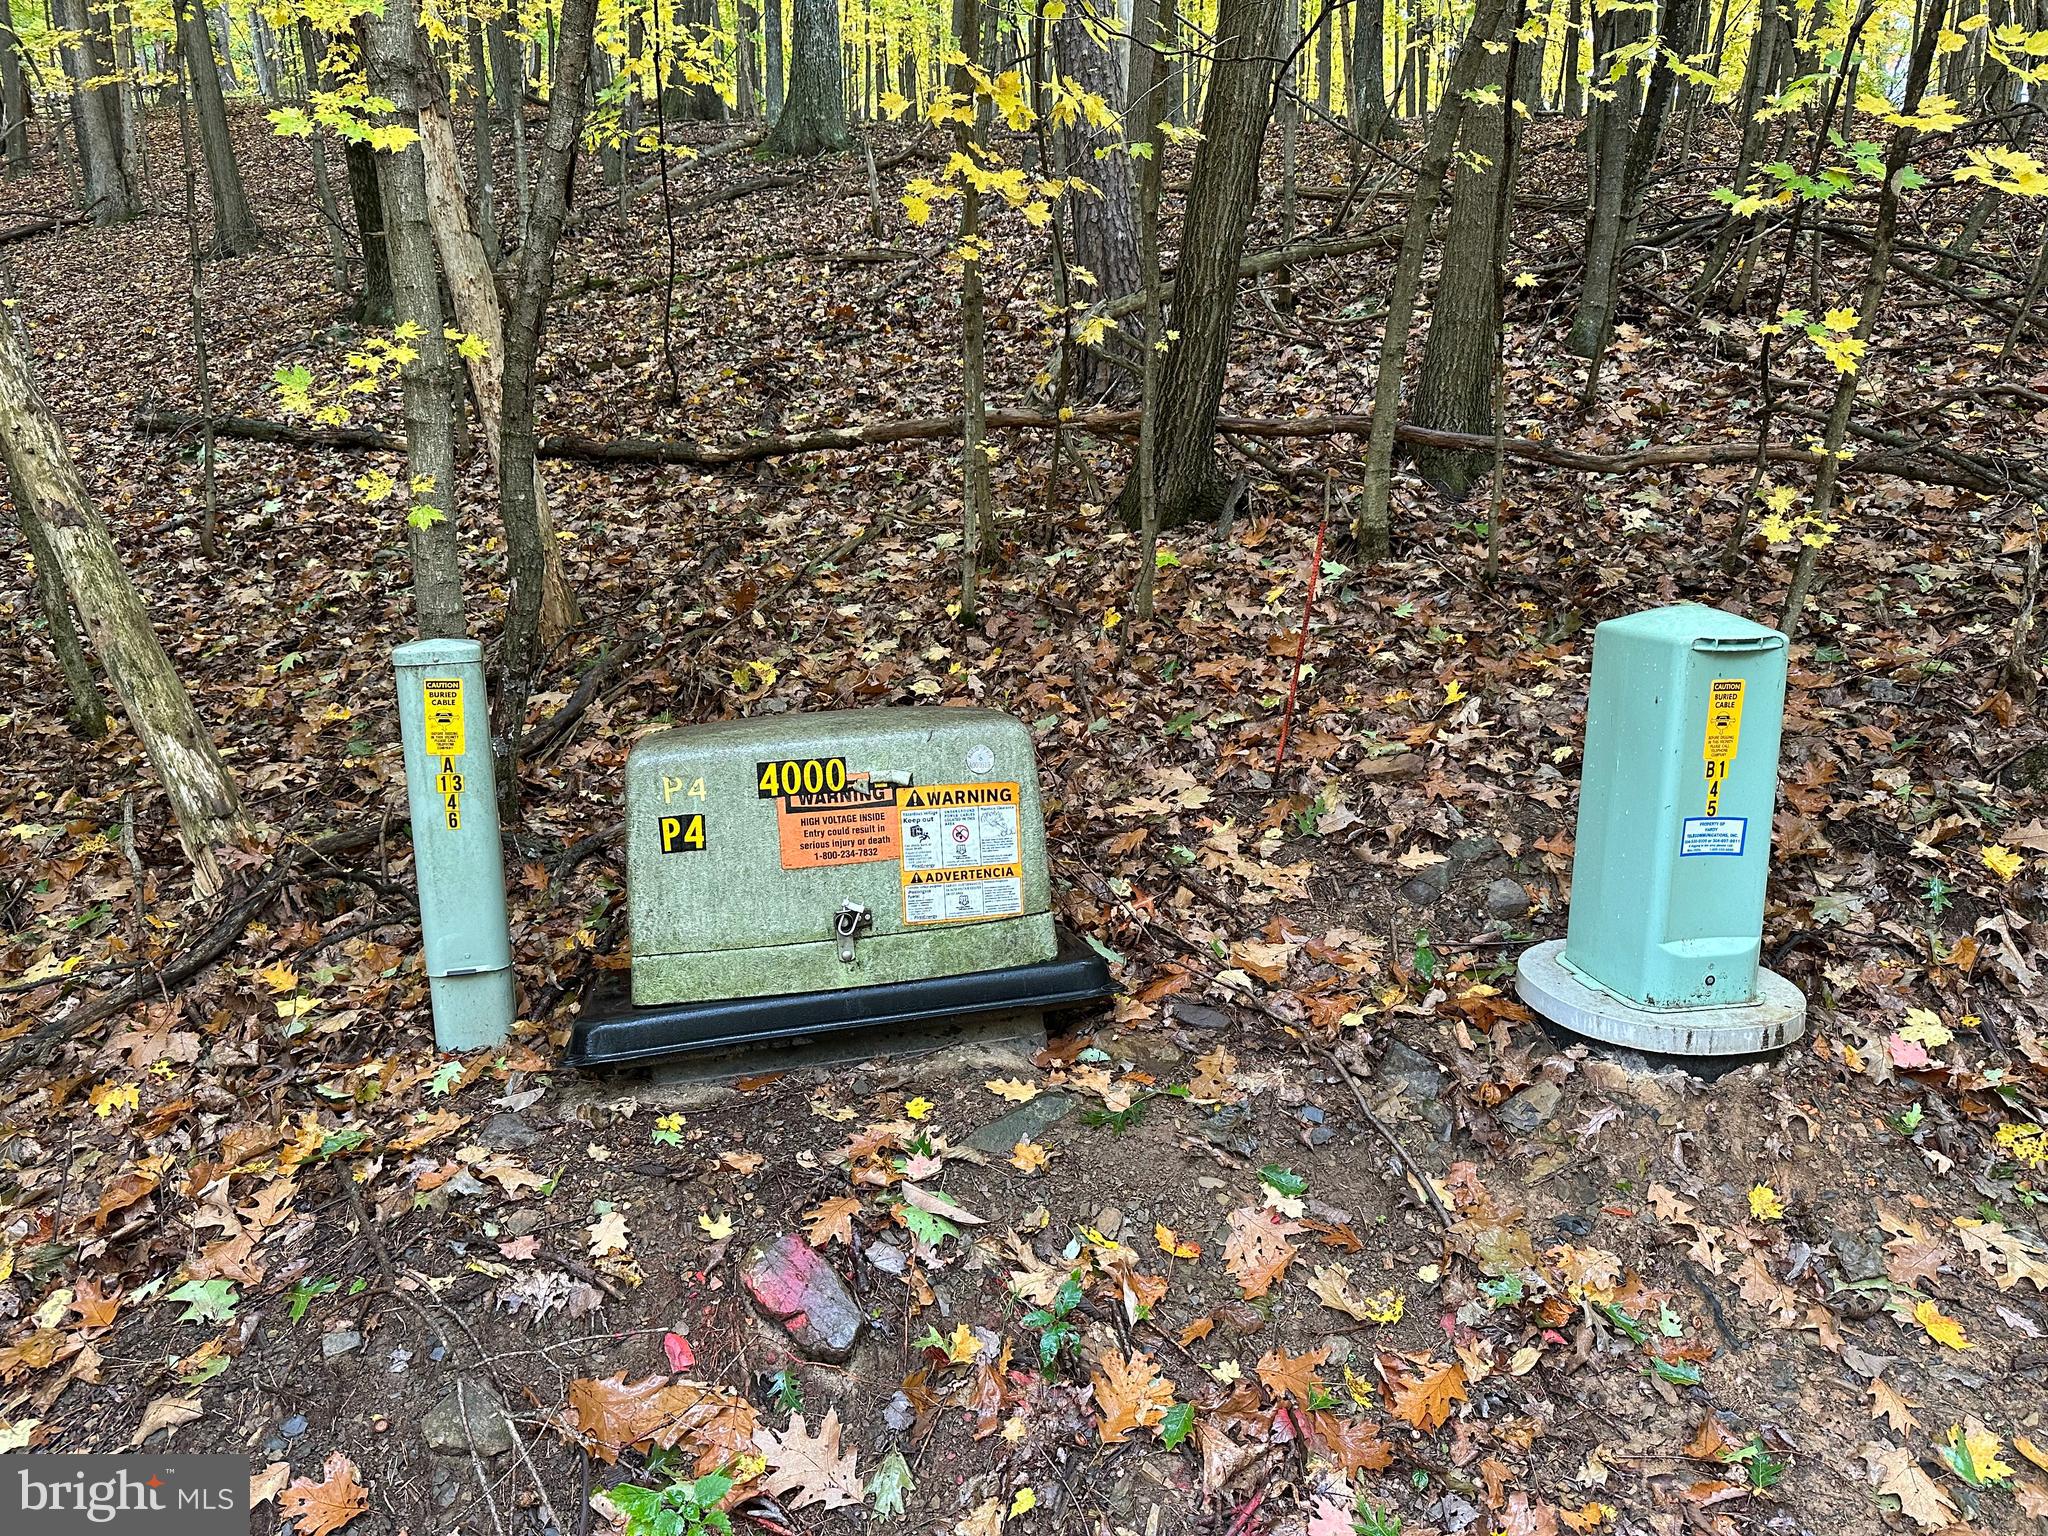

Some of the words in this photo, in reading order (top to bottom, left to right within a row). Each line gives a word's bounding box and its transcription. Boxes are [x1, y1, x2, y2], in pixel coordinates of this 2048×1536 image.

[1714, 693, 1738, 701] BURIED
[443, 757, 454, 773] A
[1706, 760, 1725, 778] B1
[440, 775, 463, 791] 13
[759, 758, 846, 797] 4000
[799, 786, 885, 806] WARNING
[1709, 780, 1718, 797] 4
[447, 794, 457, 809] 4
[926, 788, 1012, 806] WARNING
[1706, 800, 1717, 817] 5
[448, 812, 458, 828] 6
[800, 817, 820, 827] HIGH
[822, 814, 857, 825] VOLTAGE
[859, 812, 886, 822] INSIDE
[661, 814, 705, 852] P4
[803, 829, 825, 839] Entry
[827, 827, 850, 836] could
[852, 825, 875, 834] result
[799, 841, 830, 850] serious
[832, 838, 855, 849] injury
[868, 836, 891, 845] death
[813, 848, 878, 860] 1-800-234-7832
[925, 866, 1015, 883] ADVERTENCIA
